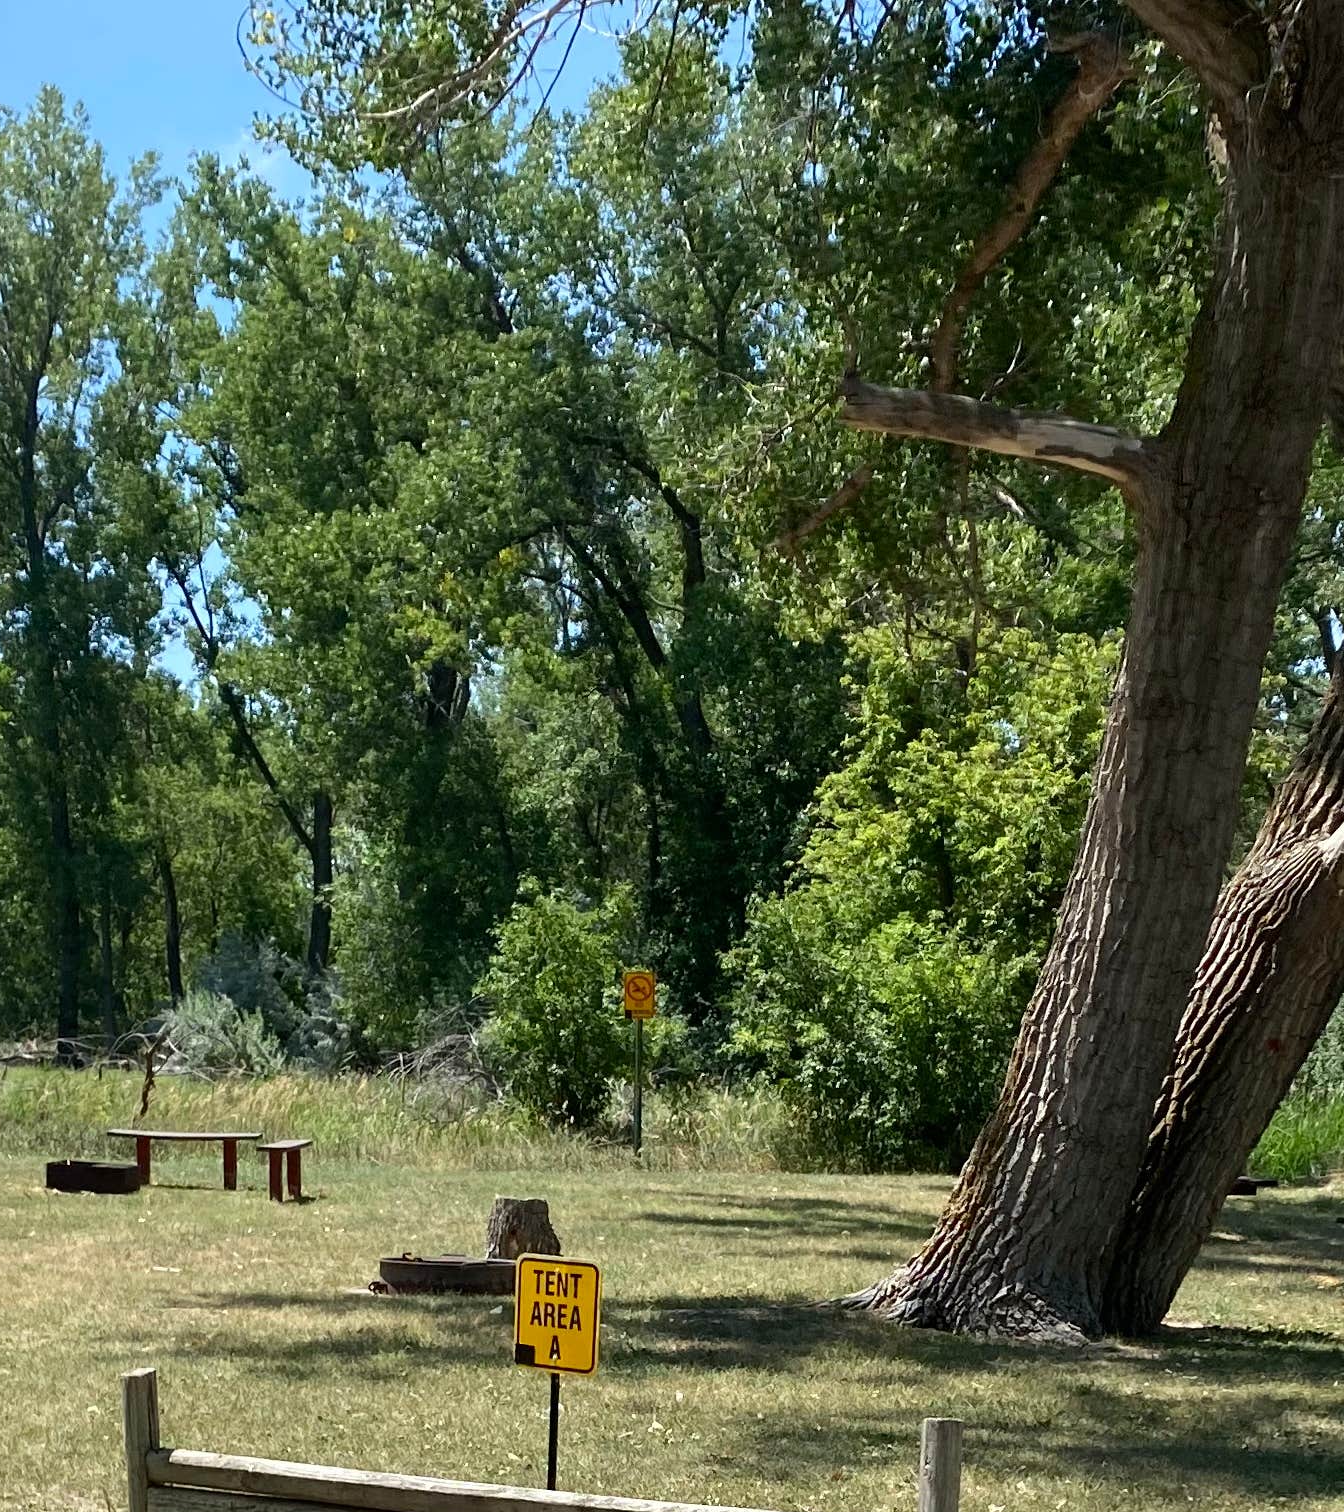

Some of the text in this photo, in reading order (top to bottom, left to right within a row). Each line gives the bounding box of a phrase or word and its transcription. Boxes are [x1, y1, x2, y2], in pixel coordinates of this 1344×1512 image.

[533, 1269, 583, 1299] TENT
[530, 1301, 582, 1332] AREA
[549, 1335, 561, 1361] A
